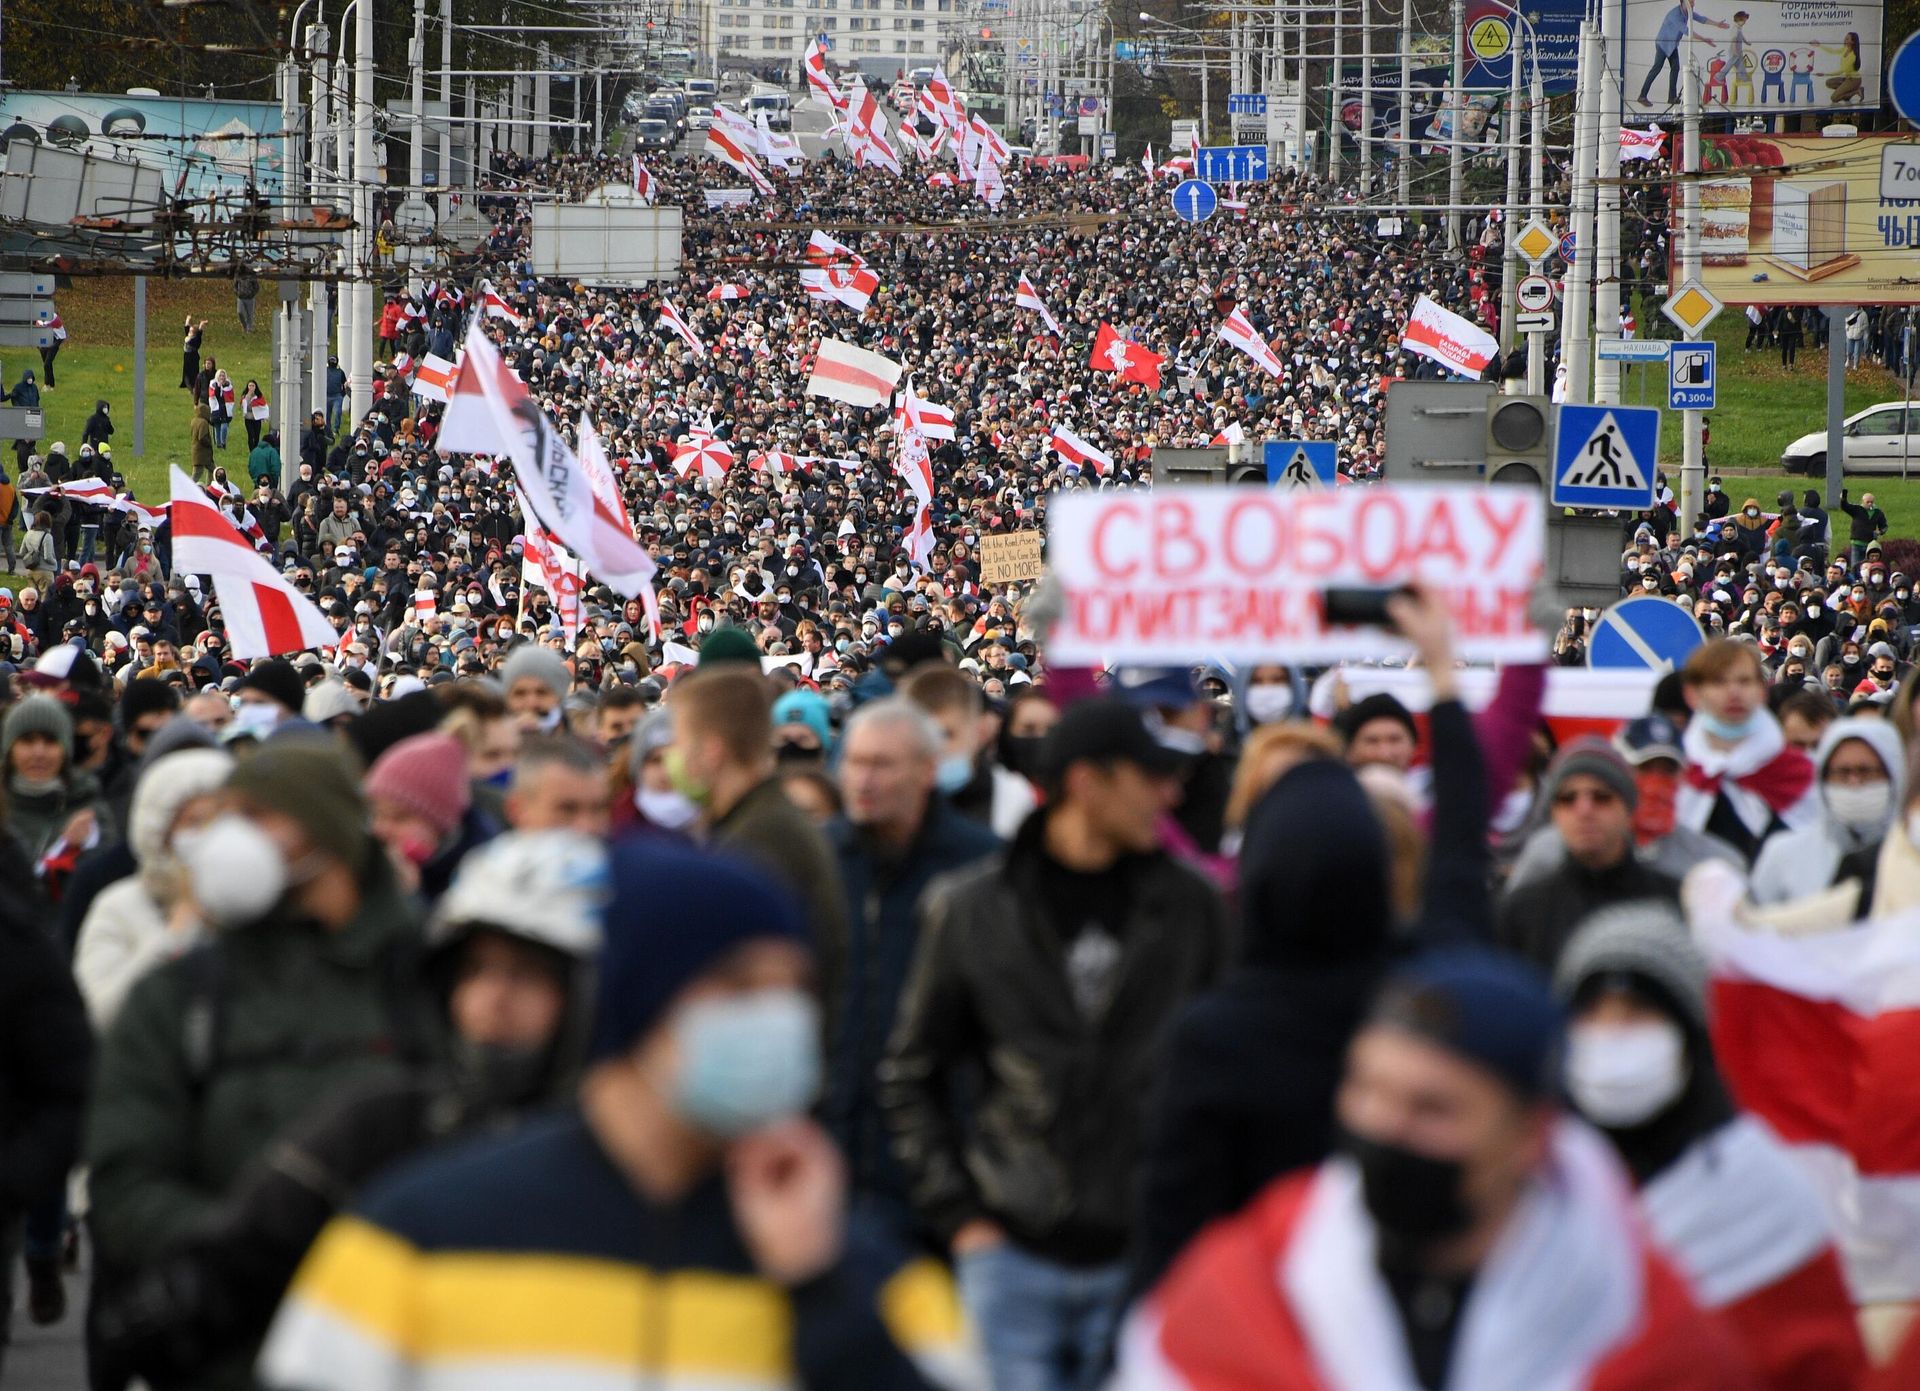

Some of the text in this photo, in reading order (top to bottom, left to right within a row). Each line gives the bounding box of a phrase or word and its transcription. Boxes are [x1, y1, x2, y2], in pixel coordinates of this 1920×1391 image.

[1781, 10, 1854, 20] ЧТО НАУЧИЛИ!
[1091, 493, 1528, 582] СВОБОДУ
[998, 560, 1041, 579] NO MORE
